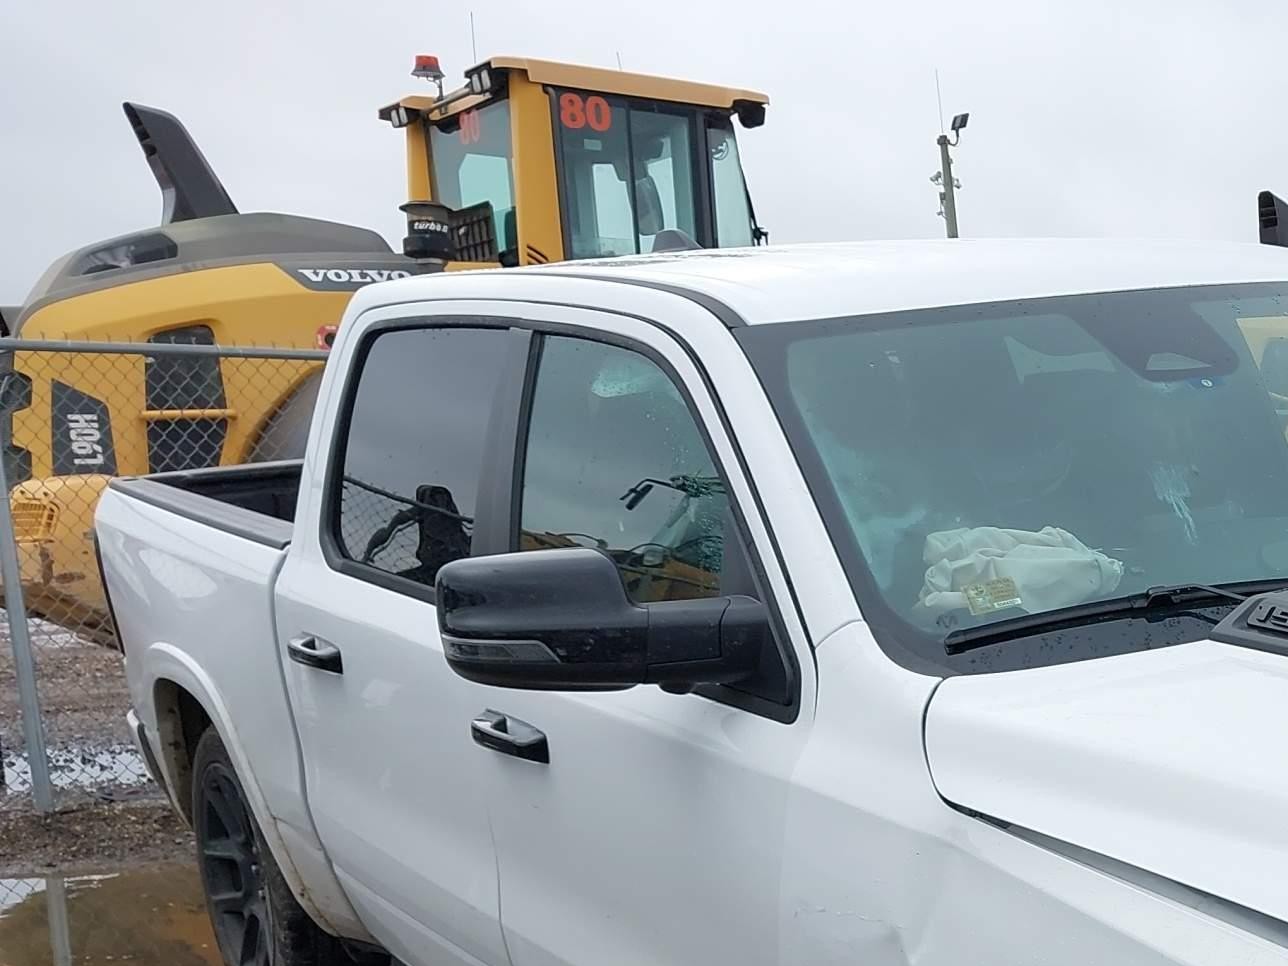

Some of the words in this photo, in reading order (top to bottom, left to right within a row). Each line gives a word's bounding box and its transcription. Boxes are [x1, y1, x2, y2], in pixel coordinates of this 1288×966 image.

[559, 92, 612, 131] 80
[298, 269, 412, 282] VOLVO
[66, 413, 105, 465] L90H
